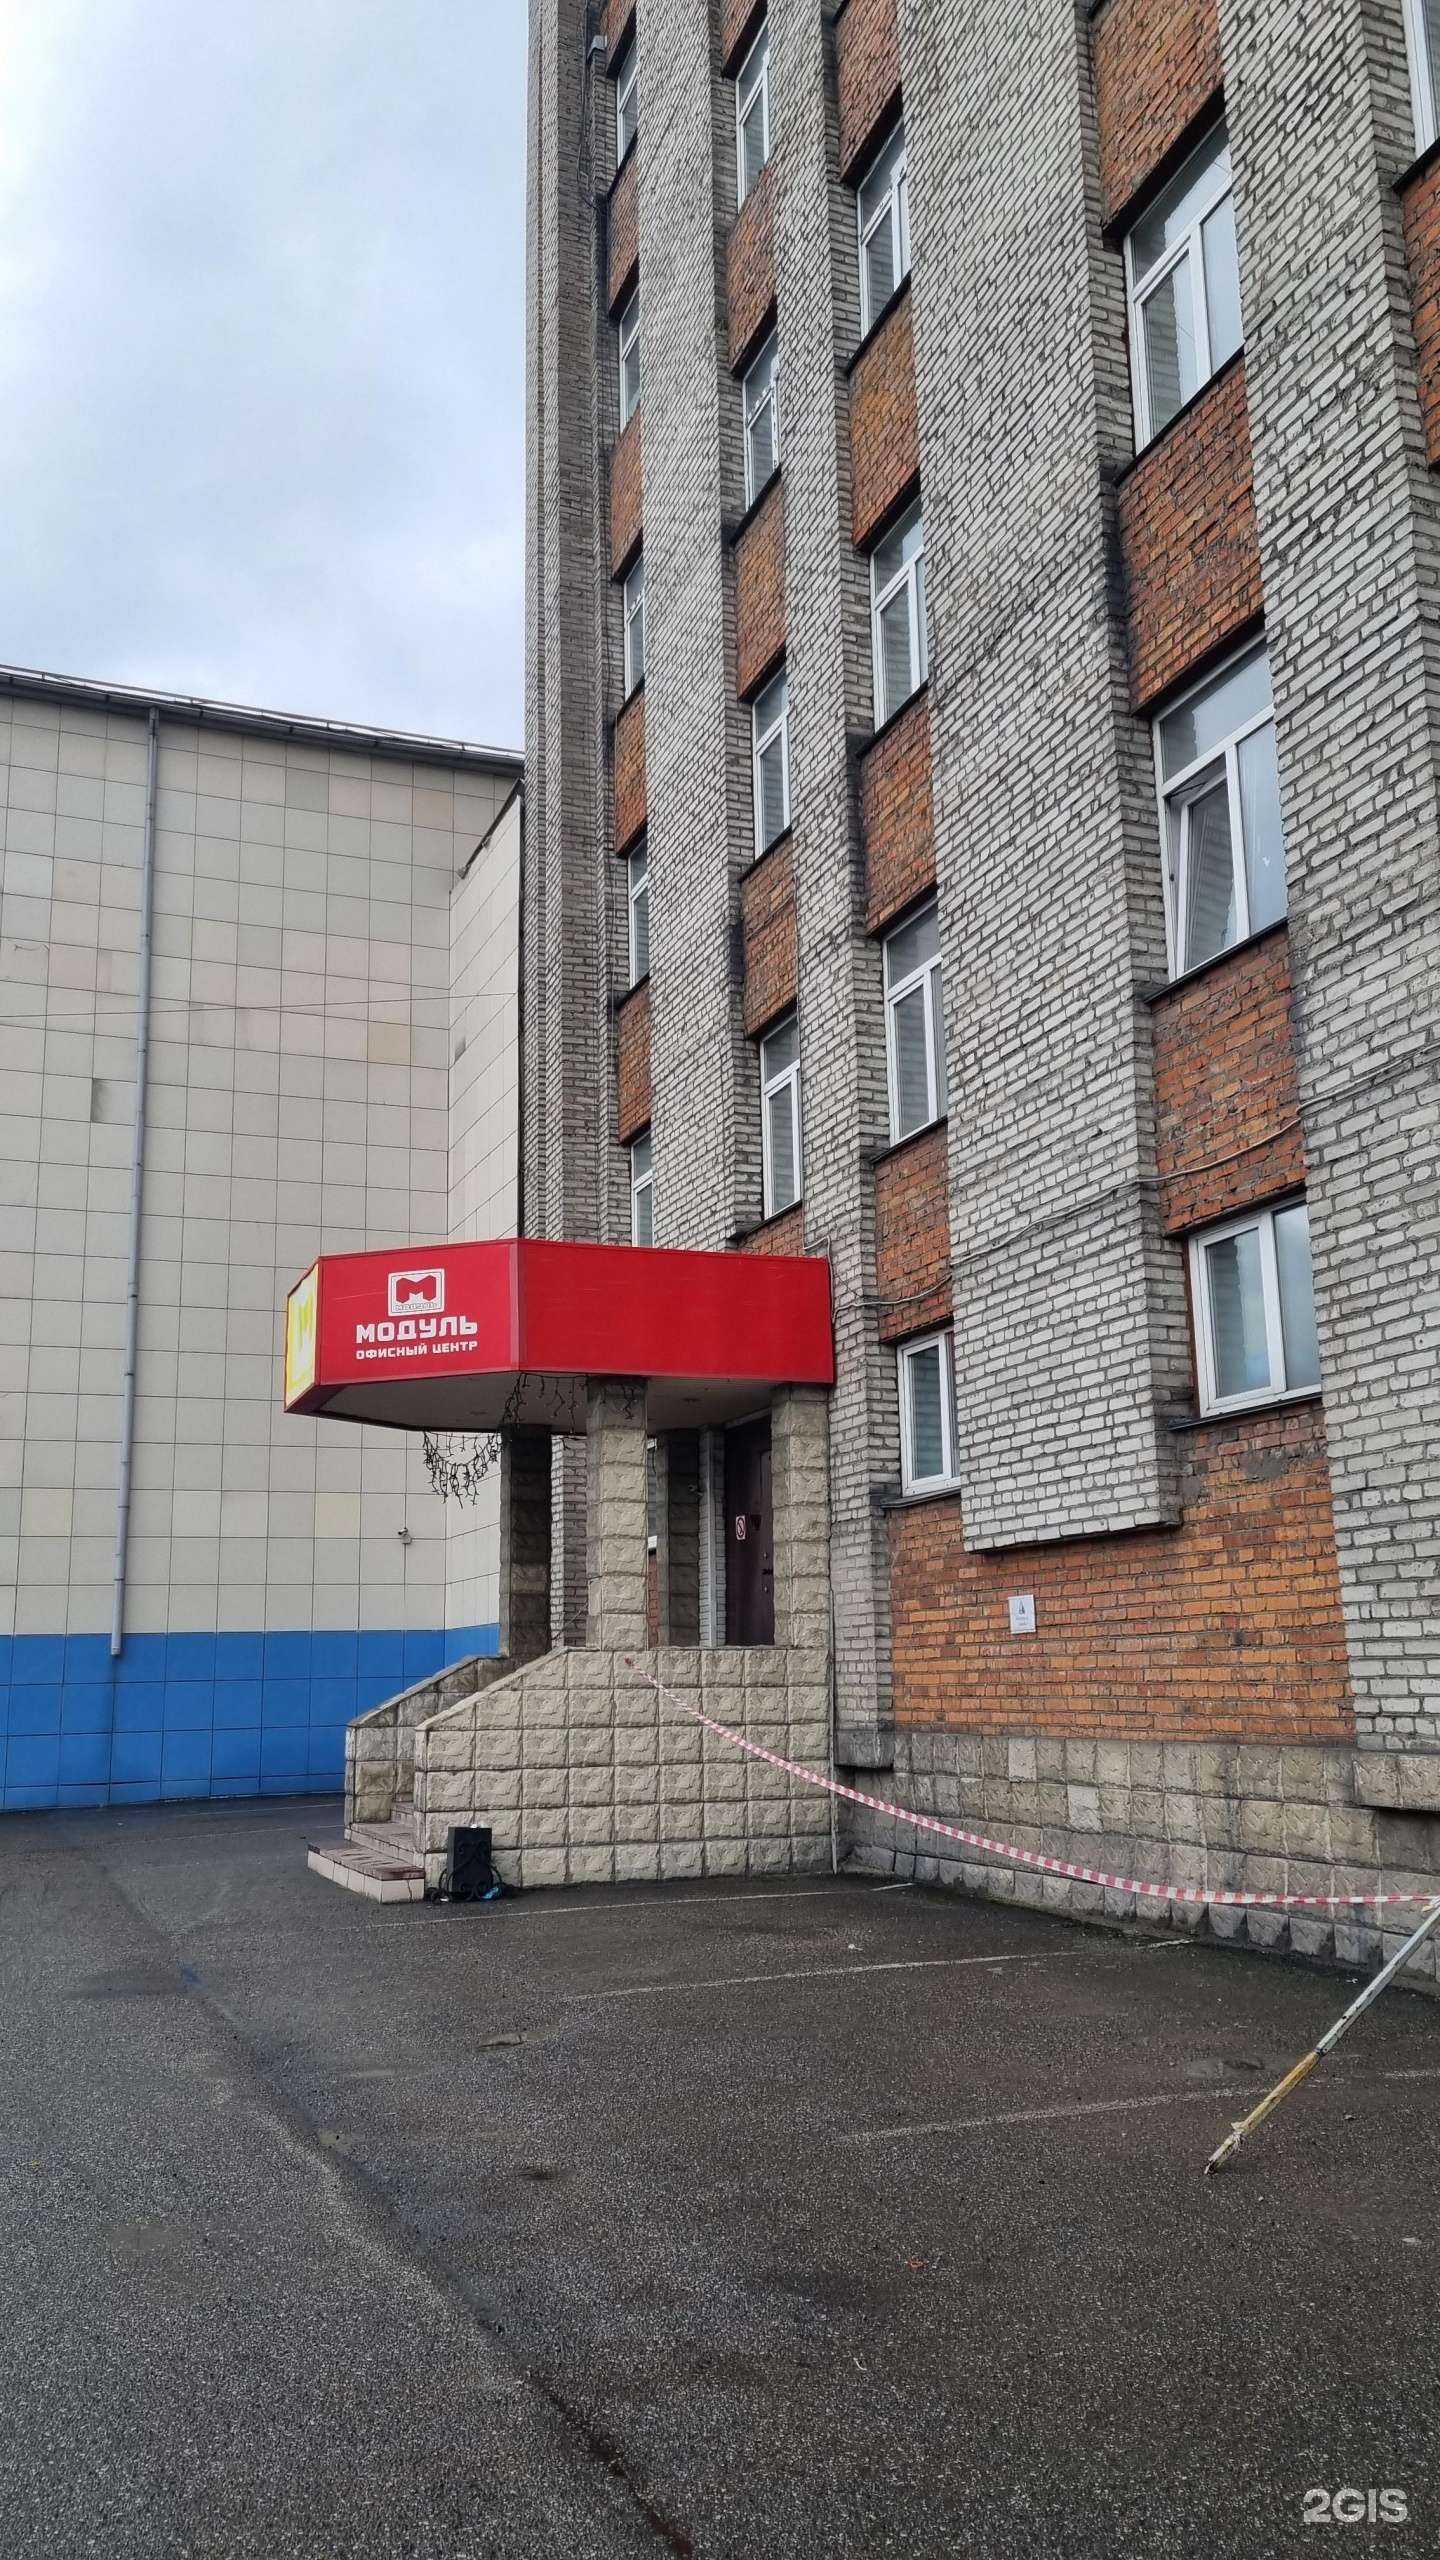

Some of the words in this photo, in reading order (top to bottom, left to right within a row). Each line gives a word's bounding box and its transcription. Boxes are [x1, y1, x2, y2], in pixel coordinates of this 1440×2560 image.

[356, 1316, 478, 1343] МОДУЛЬ
[356, 1343, 427, 1359] ОФИСНЫЙ
[432, 1341, 478, 1354] ЦЕНТР
